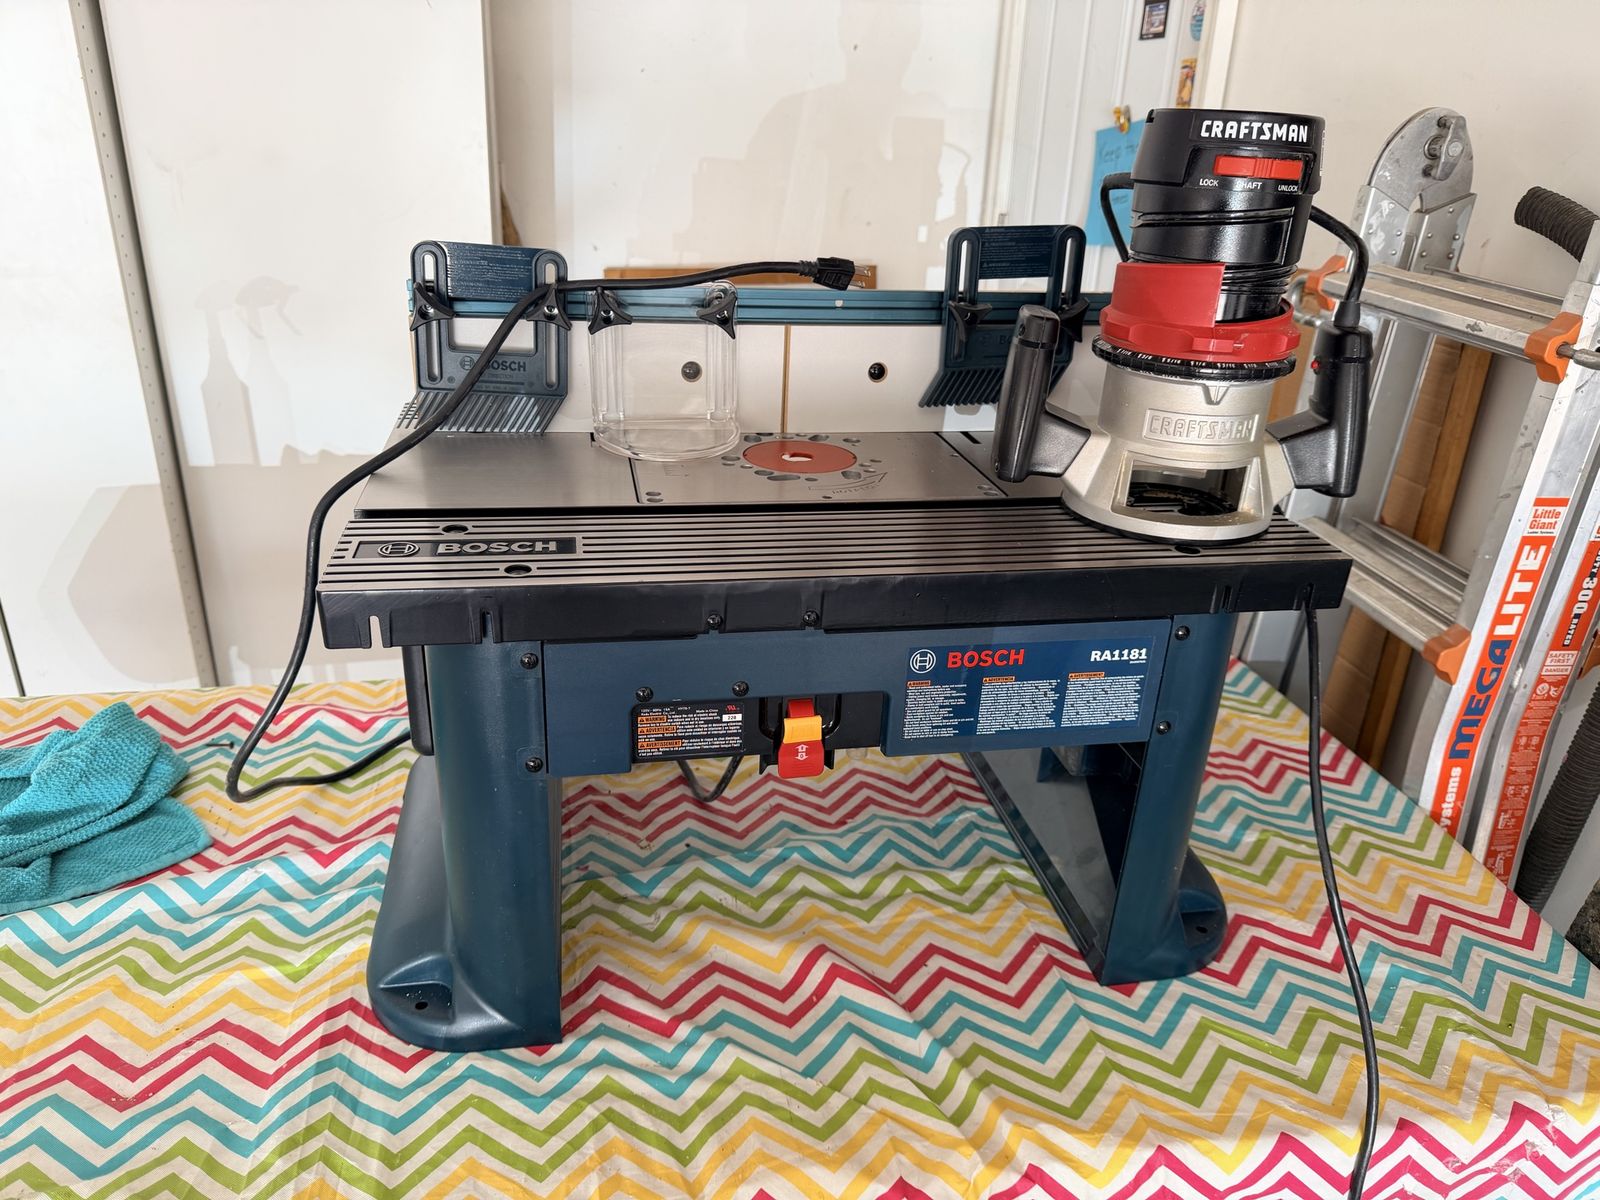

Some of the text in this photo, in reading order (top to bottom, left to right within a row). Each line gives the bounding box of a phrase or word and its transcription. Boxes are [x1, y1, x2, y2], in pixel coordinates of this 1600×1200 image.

[1200, 119, 1308, 143] CRAFTSMAN
[1199, 178, 1298, 192] LOCK SHAFT UNLOCK
[488, 359, 527, 372] OSCH
[1149, 415, 1252, 440] CRAFTSMAN
[1533, 508, 1561, 519] Little
[1529, 519, 1557, 530] Giant
[435, 541, 558, 556] BOSCH
[1572, 577, 1598, 614] 300
[947, 648, 1025, 669] BOSCH
[1090, 648, 1148, 662] RA1181
[645, 740, 681, 748] AVERTISSEMENT
[1440, 766, 1462, 832] ystems
